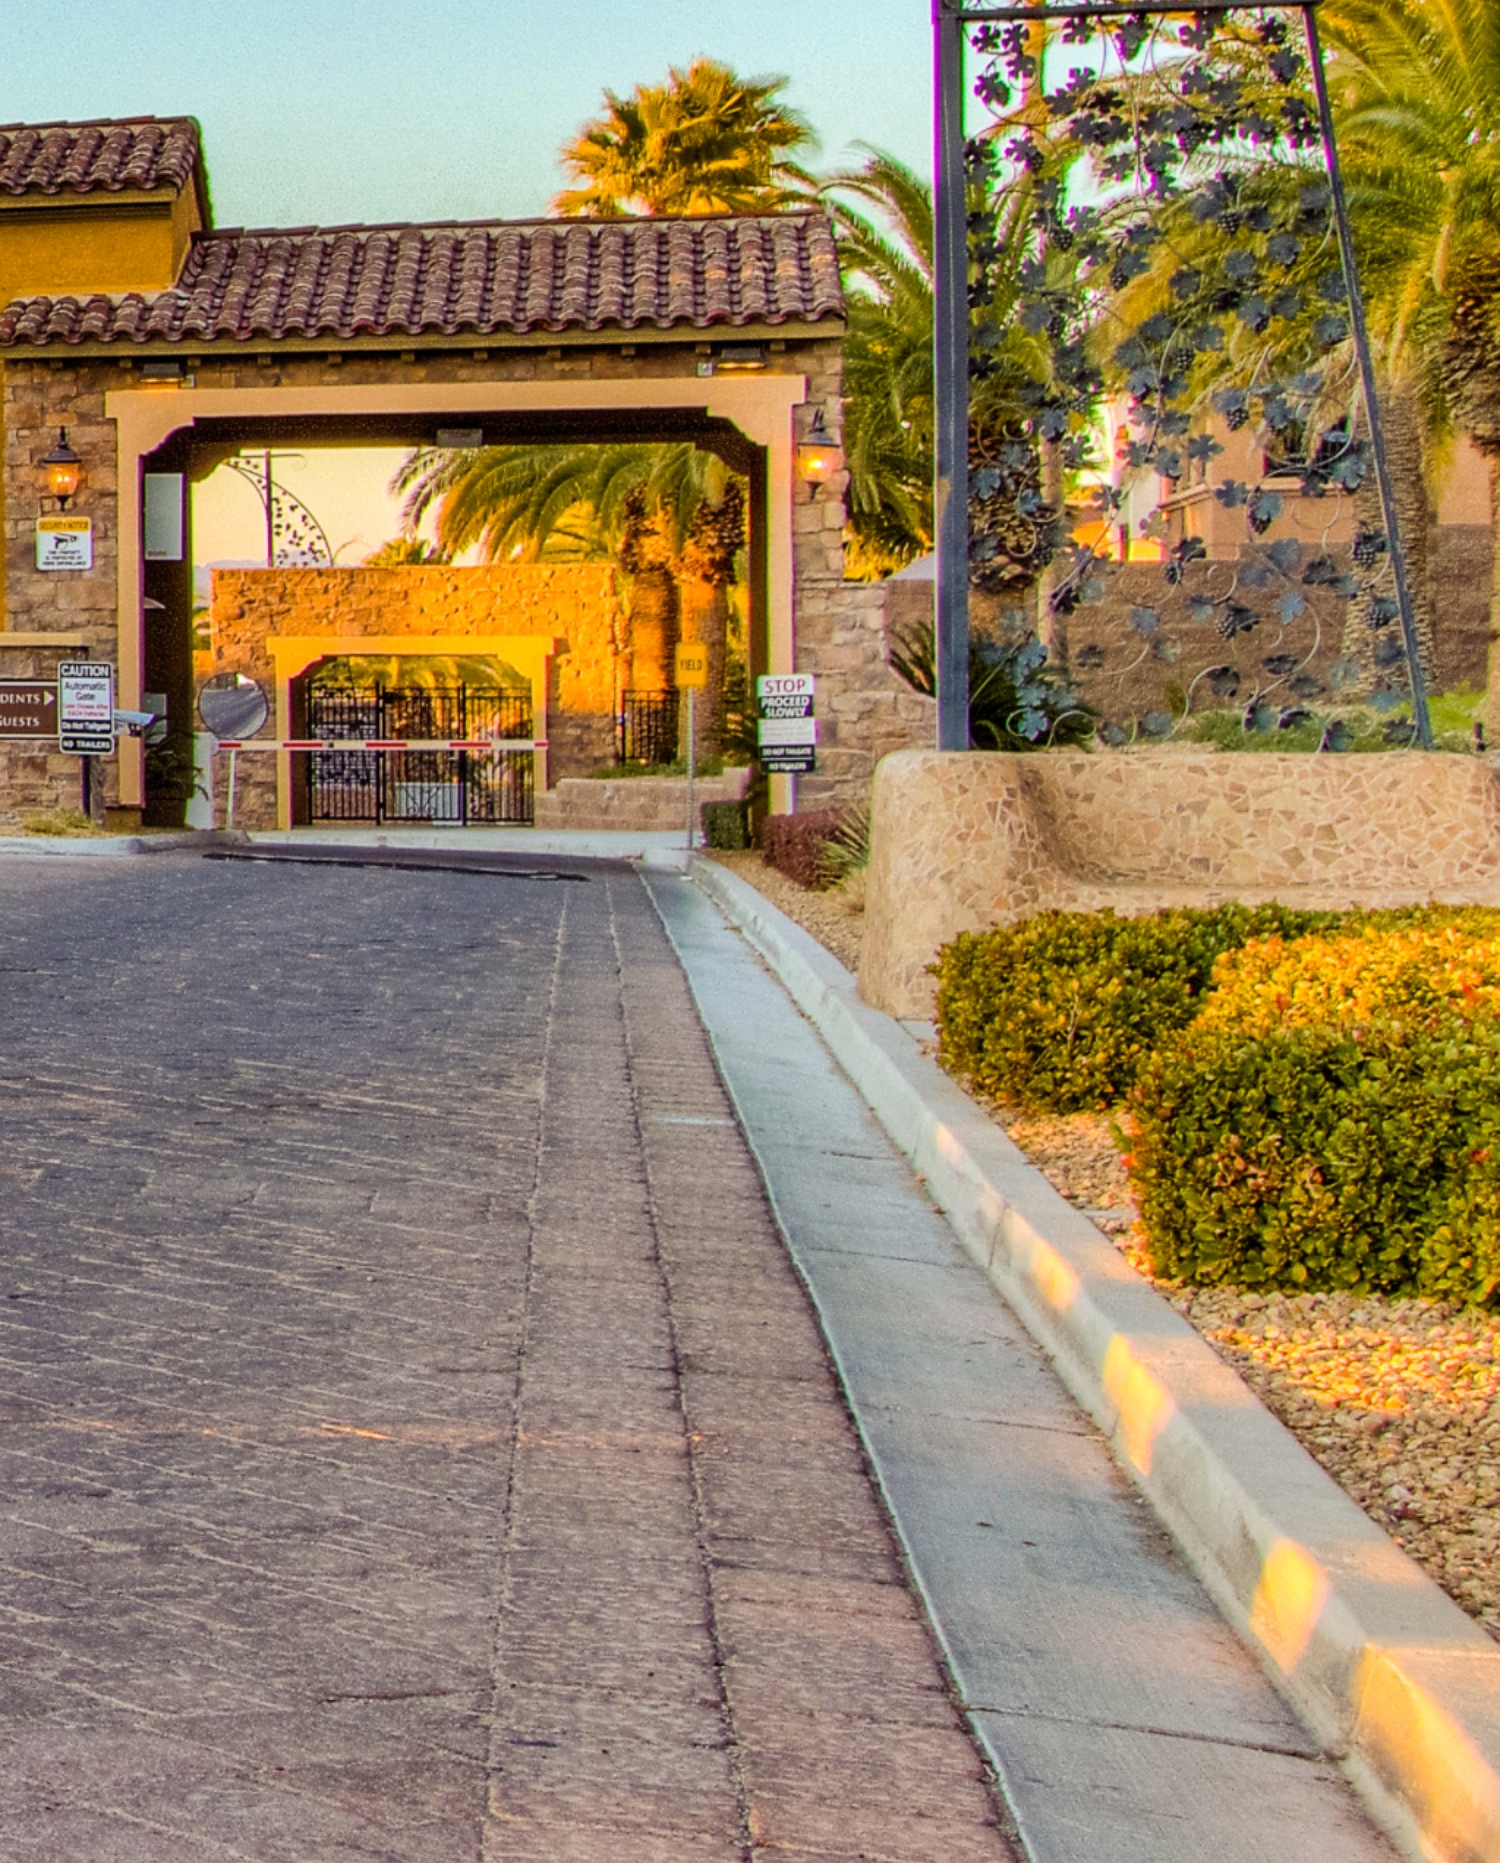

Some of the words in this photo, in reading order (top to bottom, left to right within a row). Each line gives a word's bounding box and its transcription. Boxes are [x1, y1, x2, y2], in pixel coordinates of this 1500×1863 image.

[680, 659, 702, 670] YIELD
[61, 665, 109, 677] CAUTION
[65, 681, 106, 691] Automatic
[765, 679, 805, 694] STOP
[75, 692, 95, 701] Gate
[762, 696, 809, 708] PROCEED
[765, 707, 805, 718] SLOWLY
[63, 740, 74, 748] NO
